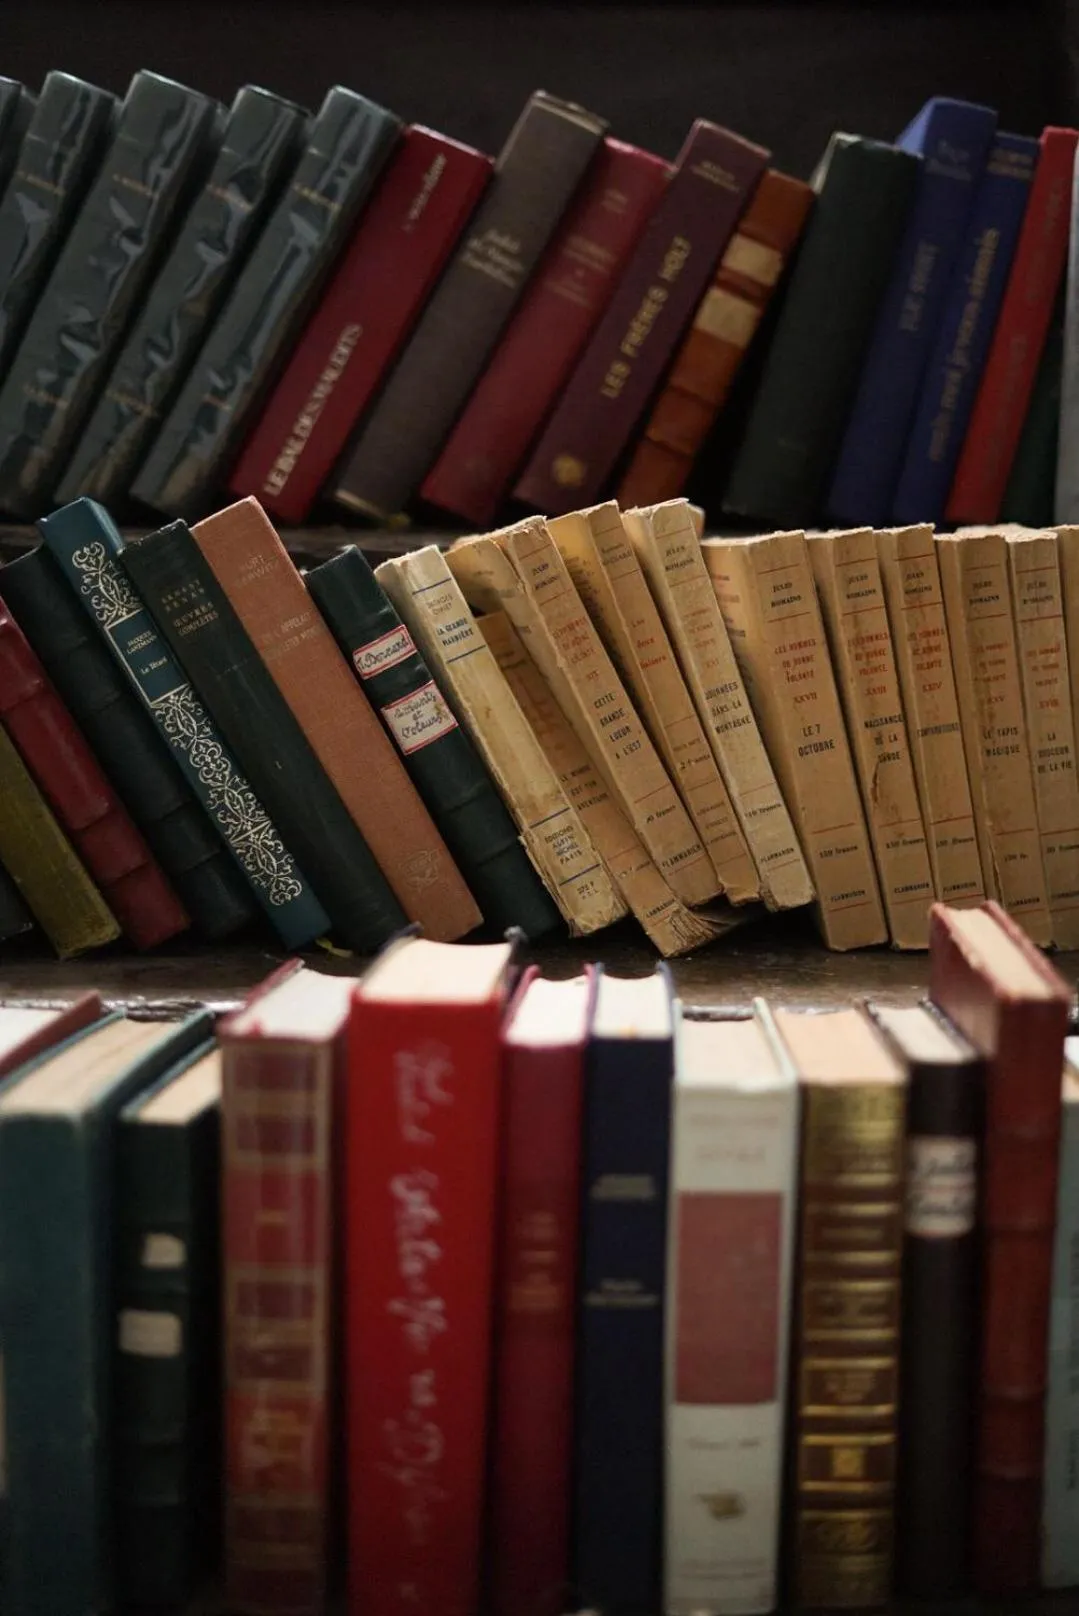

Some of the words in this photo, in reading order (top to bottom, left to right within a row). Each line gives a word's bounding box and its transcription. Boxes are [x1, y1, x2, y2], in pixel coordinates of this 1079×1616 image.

[594, 692, 616, 708] CETTE
[600, 708, 626, 727] GRANDE
[715, 715, 752, 734] MONTAGNE
[802, 726, 814, 737] LE
[983, 730, 992, 740] LE
[997, 727, 1018, 738] TAPIS
[888, 734, 898, 743] LA
[798, 739, 835, 757] OCTOBRE
[986, 745, 1020, 757] MAGIQUE
[1061, 762, 1072, 770] VIE
